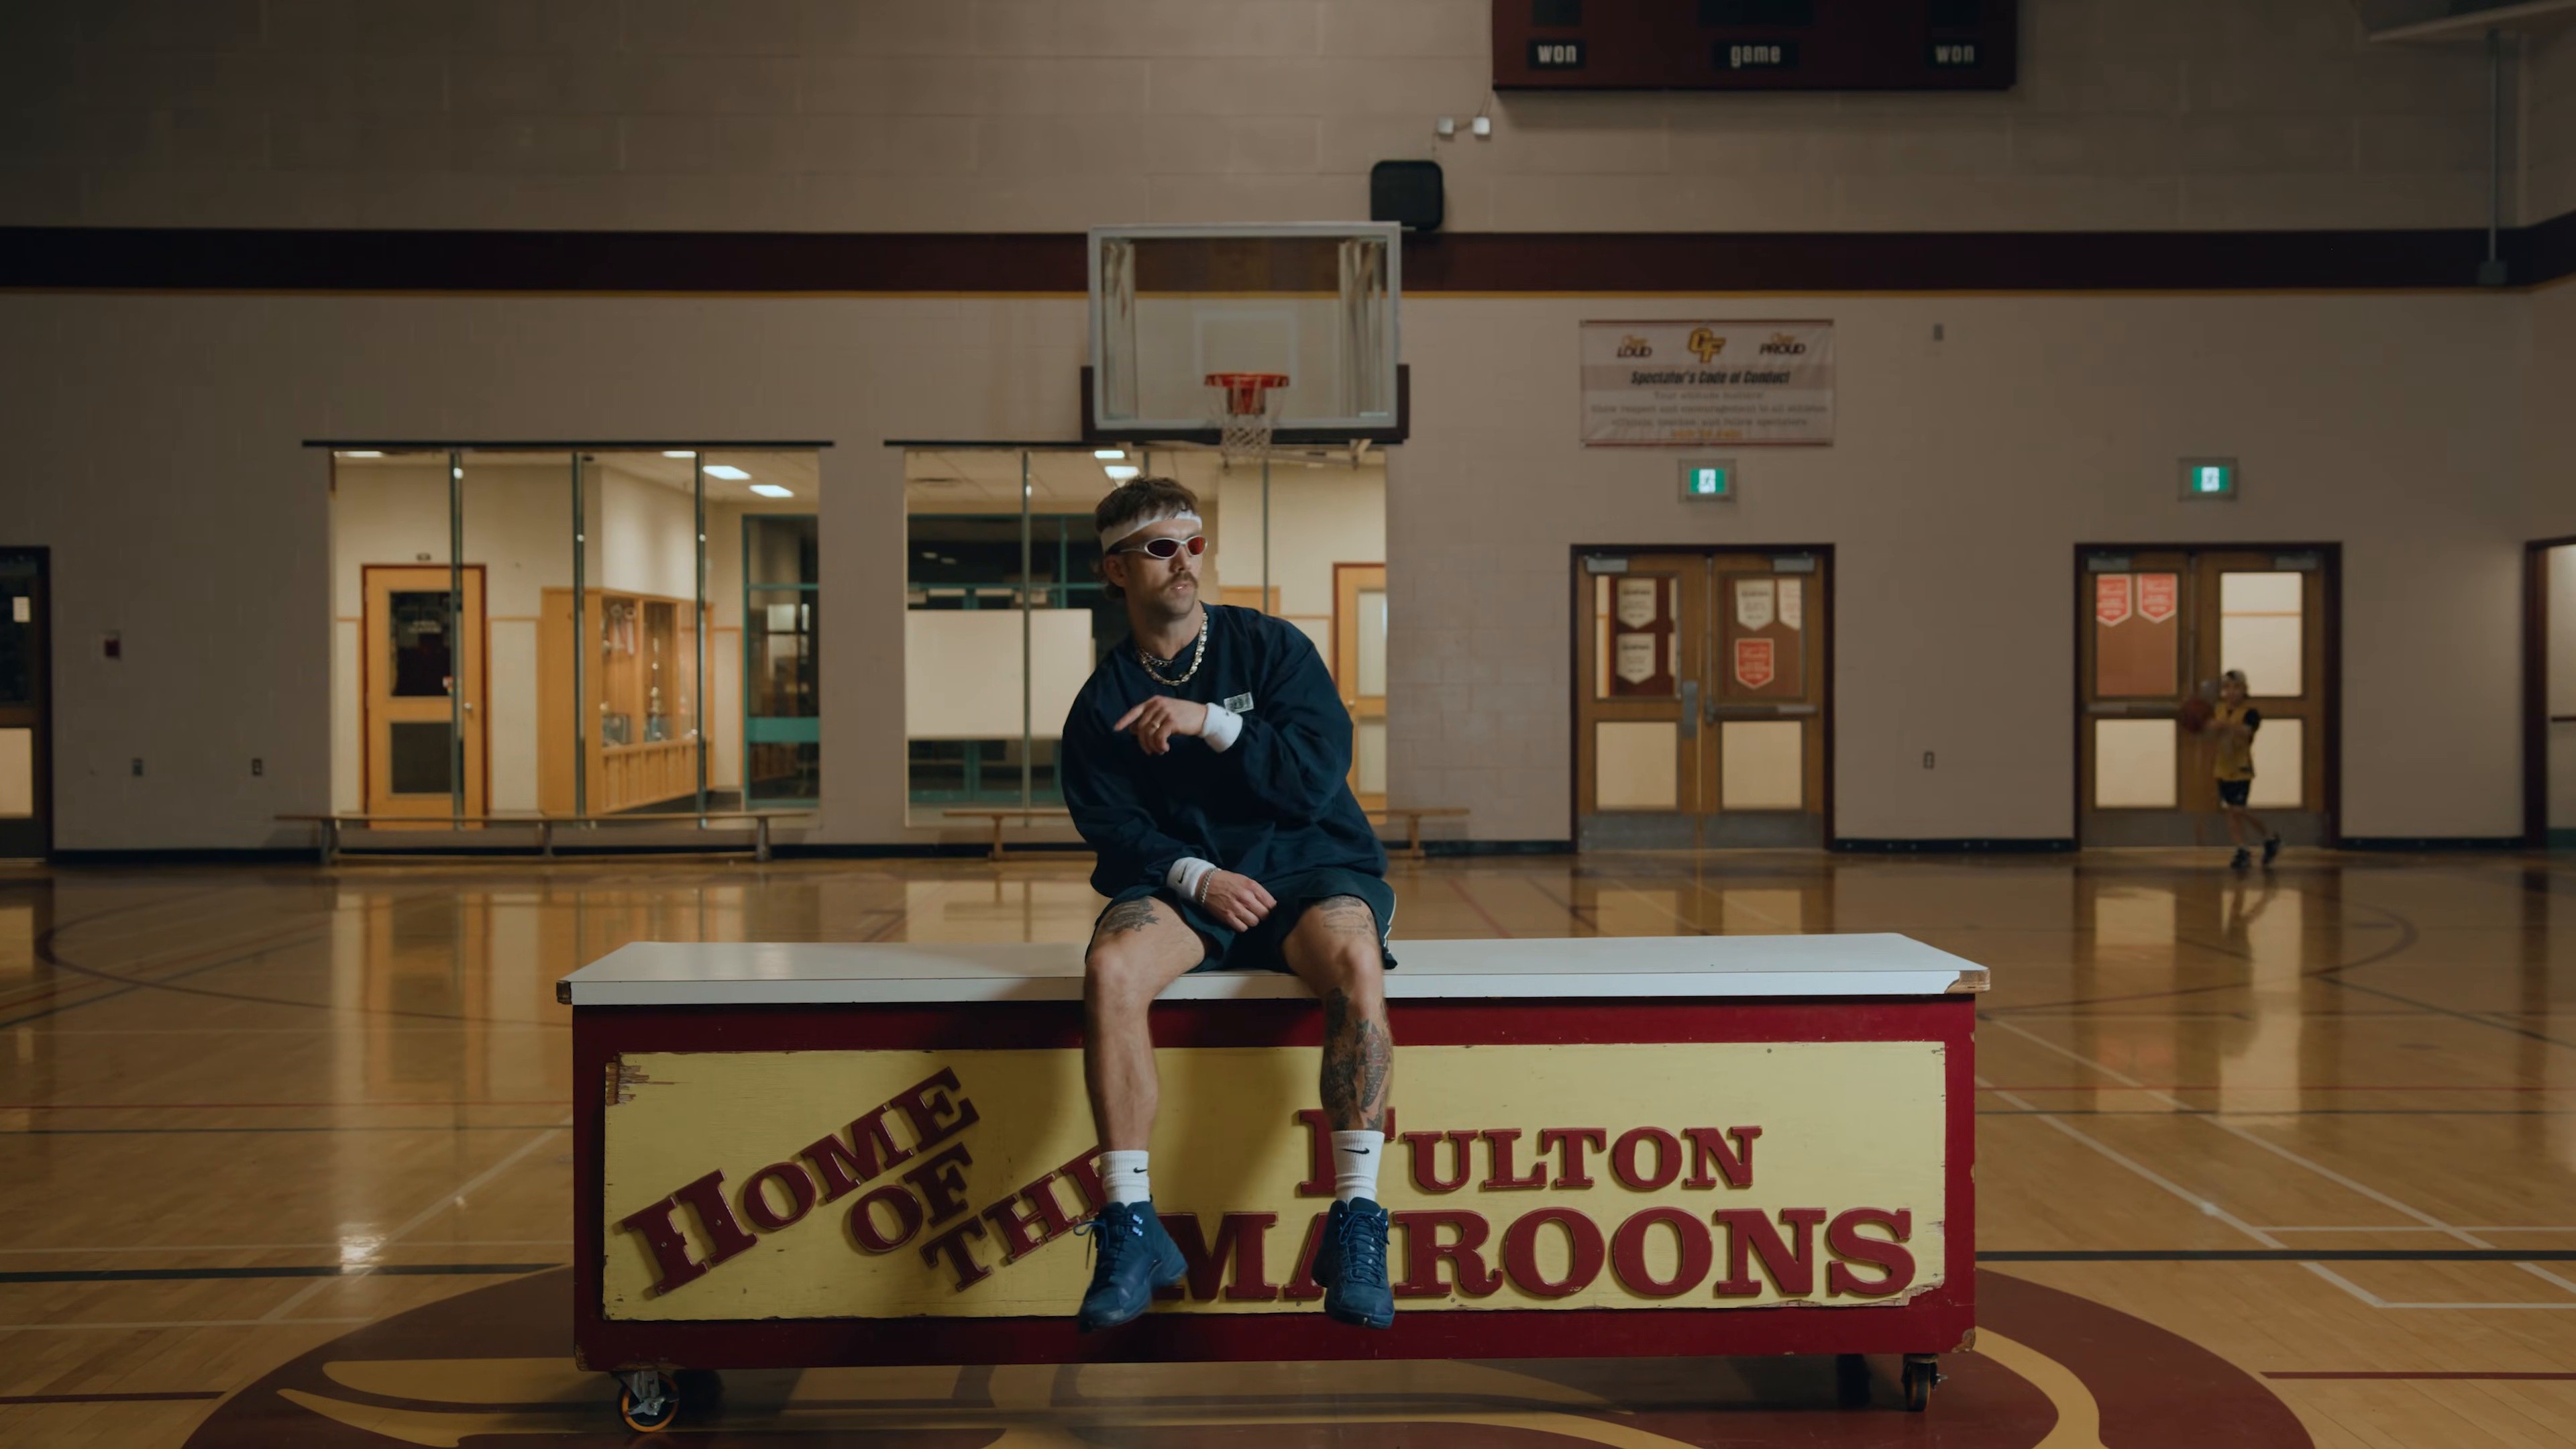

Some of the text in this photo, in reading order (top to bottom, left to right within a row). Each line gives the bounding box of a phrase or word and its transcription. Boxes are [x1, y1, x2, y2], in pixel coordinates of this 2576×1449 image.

[1537, 44, 1577, 64] won
[1729, 44, 1781, 68] game
[1935, 44, 1975, 64] won
[1617, 345, 1652, 358] LOUD
[1759, 343, 1806, 355] PROUD
[621, 1065, 980, 1297] HOME
[850, 1141, 973, 1254] OF
